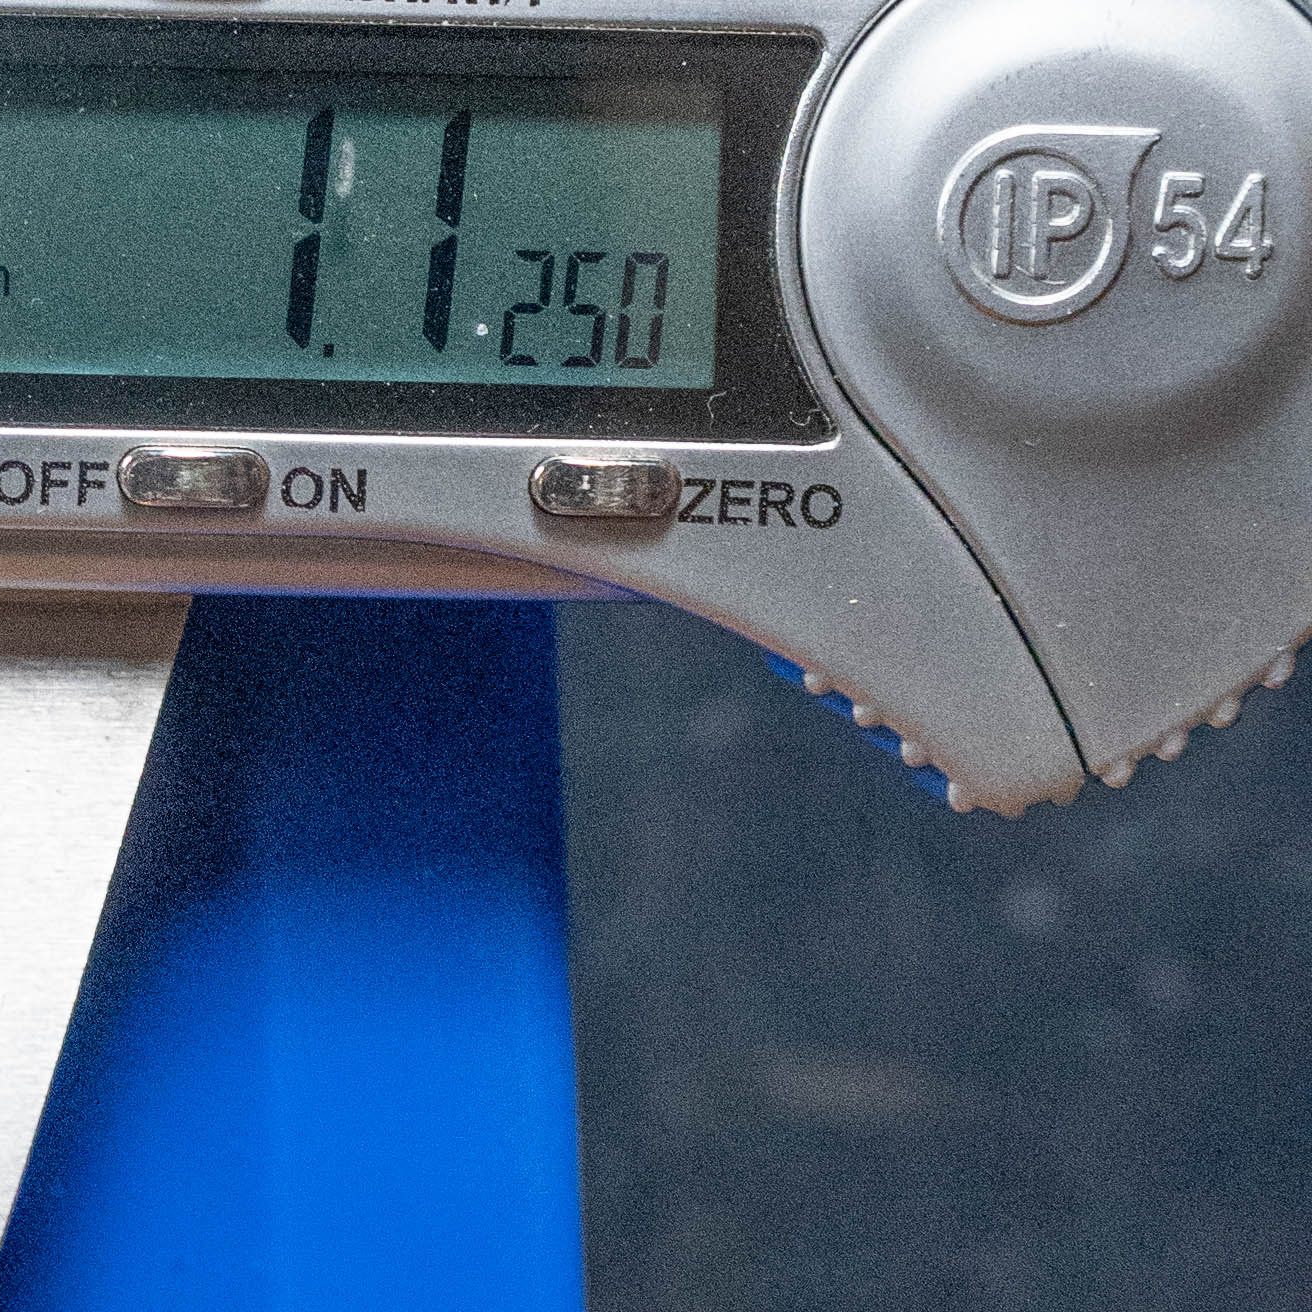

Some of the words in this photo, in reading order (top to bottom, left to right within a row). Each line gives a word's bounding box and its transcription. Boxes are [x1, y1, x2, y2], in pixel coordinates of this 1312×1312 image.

[990, 168, 1097, 281] IP
[1151, 171, 1275, 281] 54
[279, 467, 367, 513] ON
[677, 478, 844, 530] ZERO
